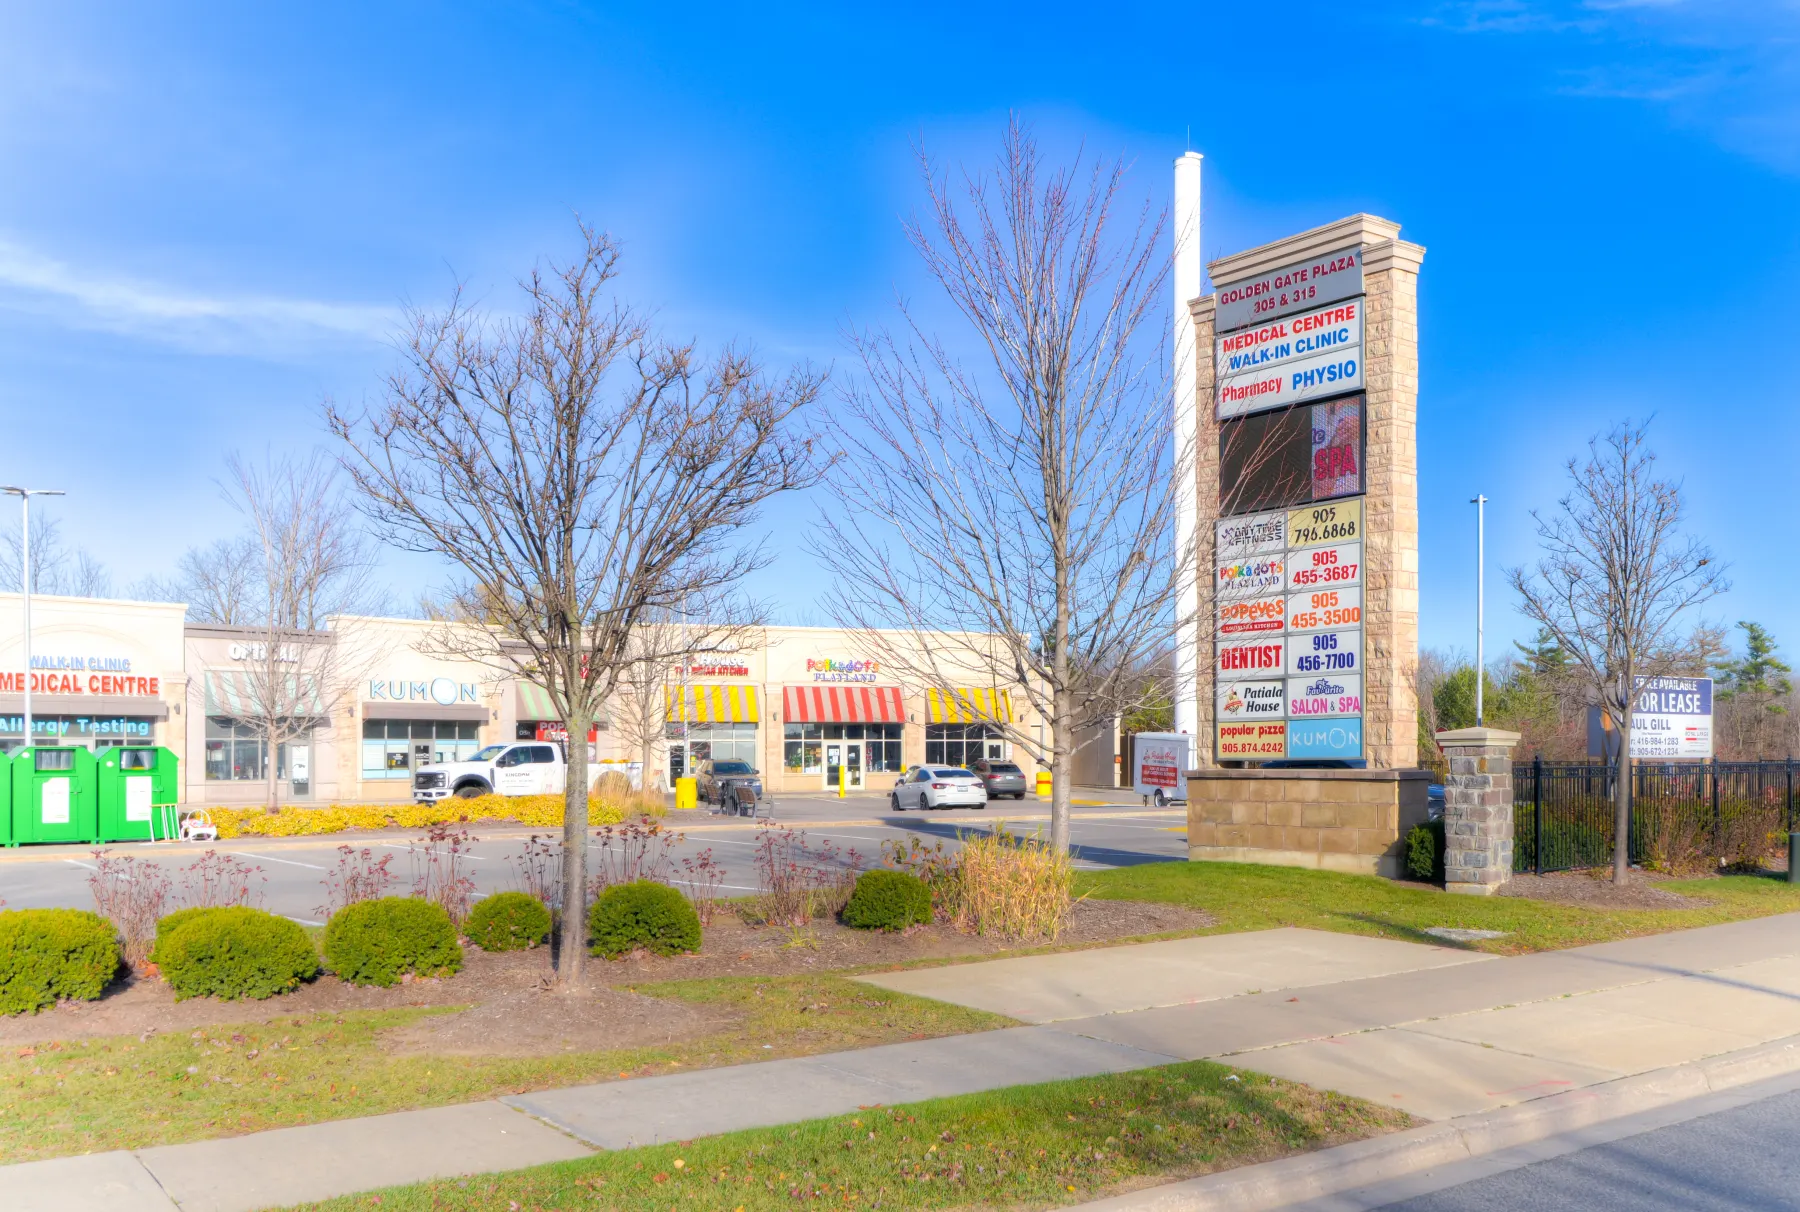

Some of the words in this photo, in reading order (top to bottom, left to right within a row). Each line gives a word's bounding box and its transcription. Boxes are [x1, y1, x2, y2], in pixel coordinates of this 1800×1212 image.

[1221, 280, 1271, 305] GOLDEN
[1275, 269, 1308, 290] GATE
[1312, 254, 1355, 279] PLAZA
[1254, 297, 1276, 314] 305
[1280, 293, 1289, 306] &
[1293, 286, 1316, 303] 315
[1223, 324, 1288, 353] MEDICAL
[1292, 305, 1356, 335] CENTRE
[1229, 342, 1290, 370] WALK-IN
[1295, 328, 1349, 354] CLINIC
[1222, 377, 1282, 403] Pharmacy
[1292, 360, 1357, 390] PHYSIO
[1314, 444, 1357, 481] SPA
[1312, 507, 1336, 524] 905
[1295, 521, 1356, 543] 796.6868
[1312, 549, 1338, 567] 905
[1293, 564, 1358, 585] 455-3687
[1311, 592, 1338, 608] 905
[1291, 607, 1360, 629] 455-3500
[1312, 633, 1338, 651] 905
[30, 655, 84, 670] WALK-IN
[88, 656, 131, 672] CLINIC
[1221, 645, 1282, 670] DENTIST
[1296, 652, 1355, 671] 456-7700
[0, 672, 83, 693] MEDICAL
[88, 674, 159, 695] CENTRE
[813, 673, 877, 683] PLAYLAND
[1659, 679, 1697, 691] AVAILABLE
[370, 677, 478, 706] KUMON
[1243, 686, 1283, 699] Patiala
[1246, 701, 1280, 713] House
[1291, 698, 1328, 715] SALON
[1330, 701, 1335, 712] &
[1338, 696, 1361, 713] SPA
[1633, 692, 1659, 712] OR
[1661, 692, 1701, 713] LEASE
[77, 718, 149, 736] Testing
[1220, 724, 1255, 740] popular
[1258, 725, 1285, 739] pizza
[1631, 718, 1648, 730] AUL
[1650, 719, 1671, 731] GILL
[1222, 742, 1283, 753] 905.874.4242
[1292, 727, 1359, 749] KUMON
